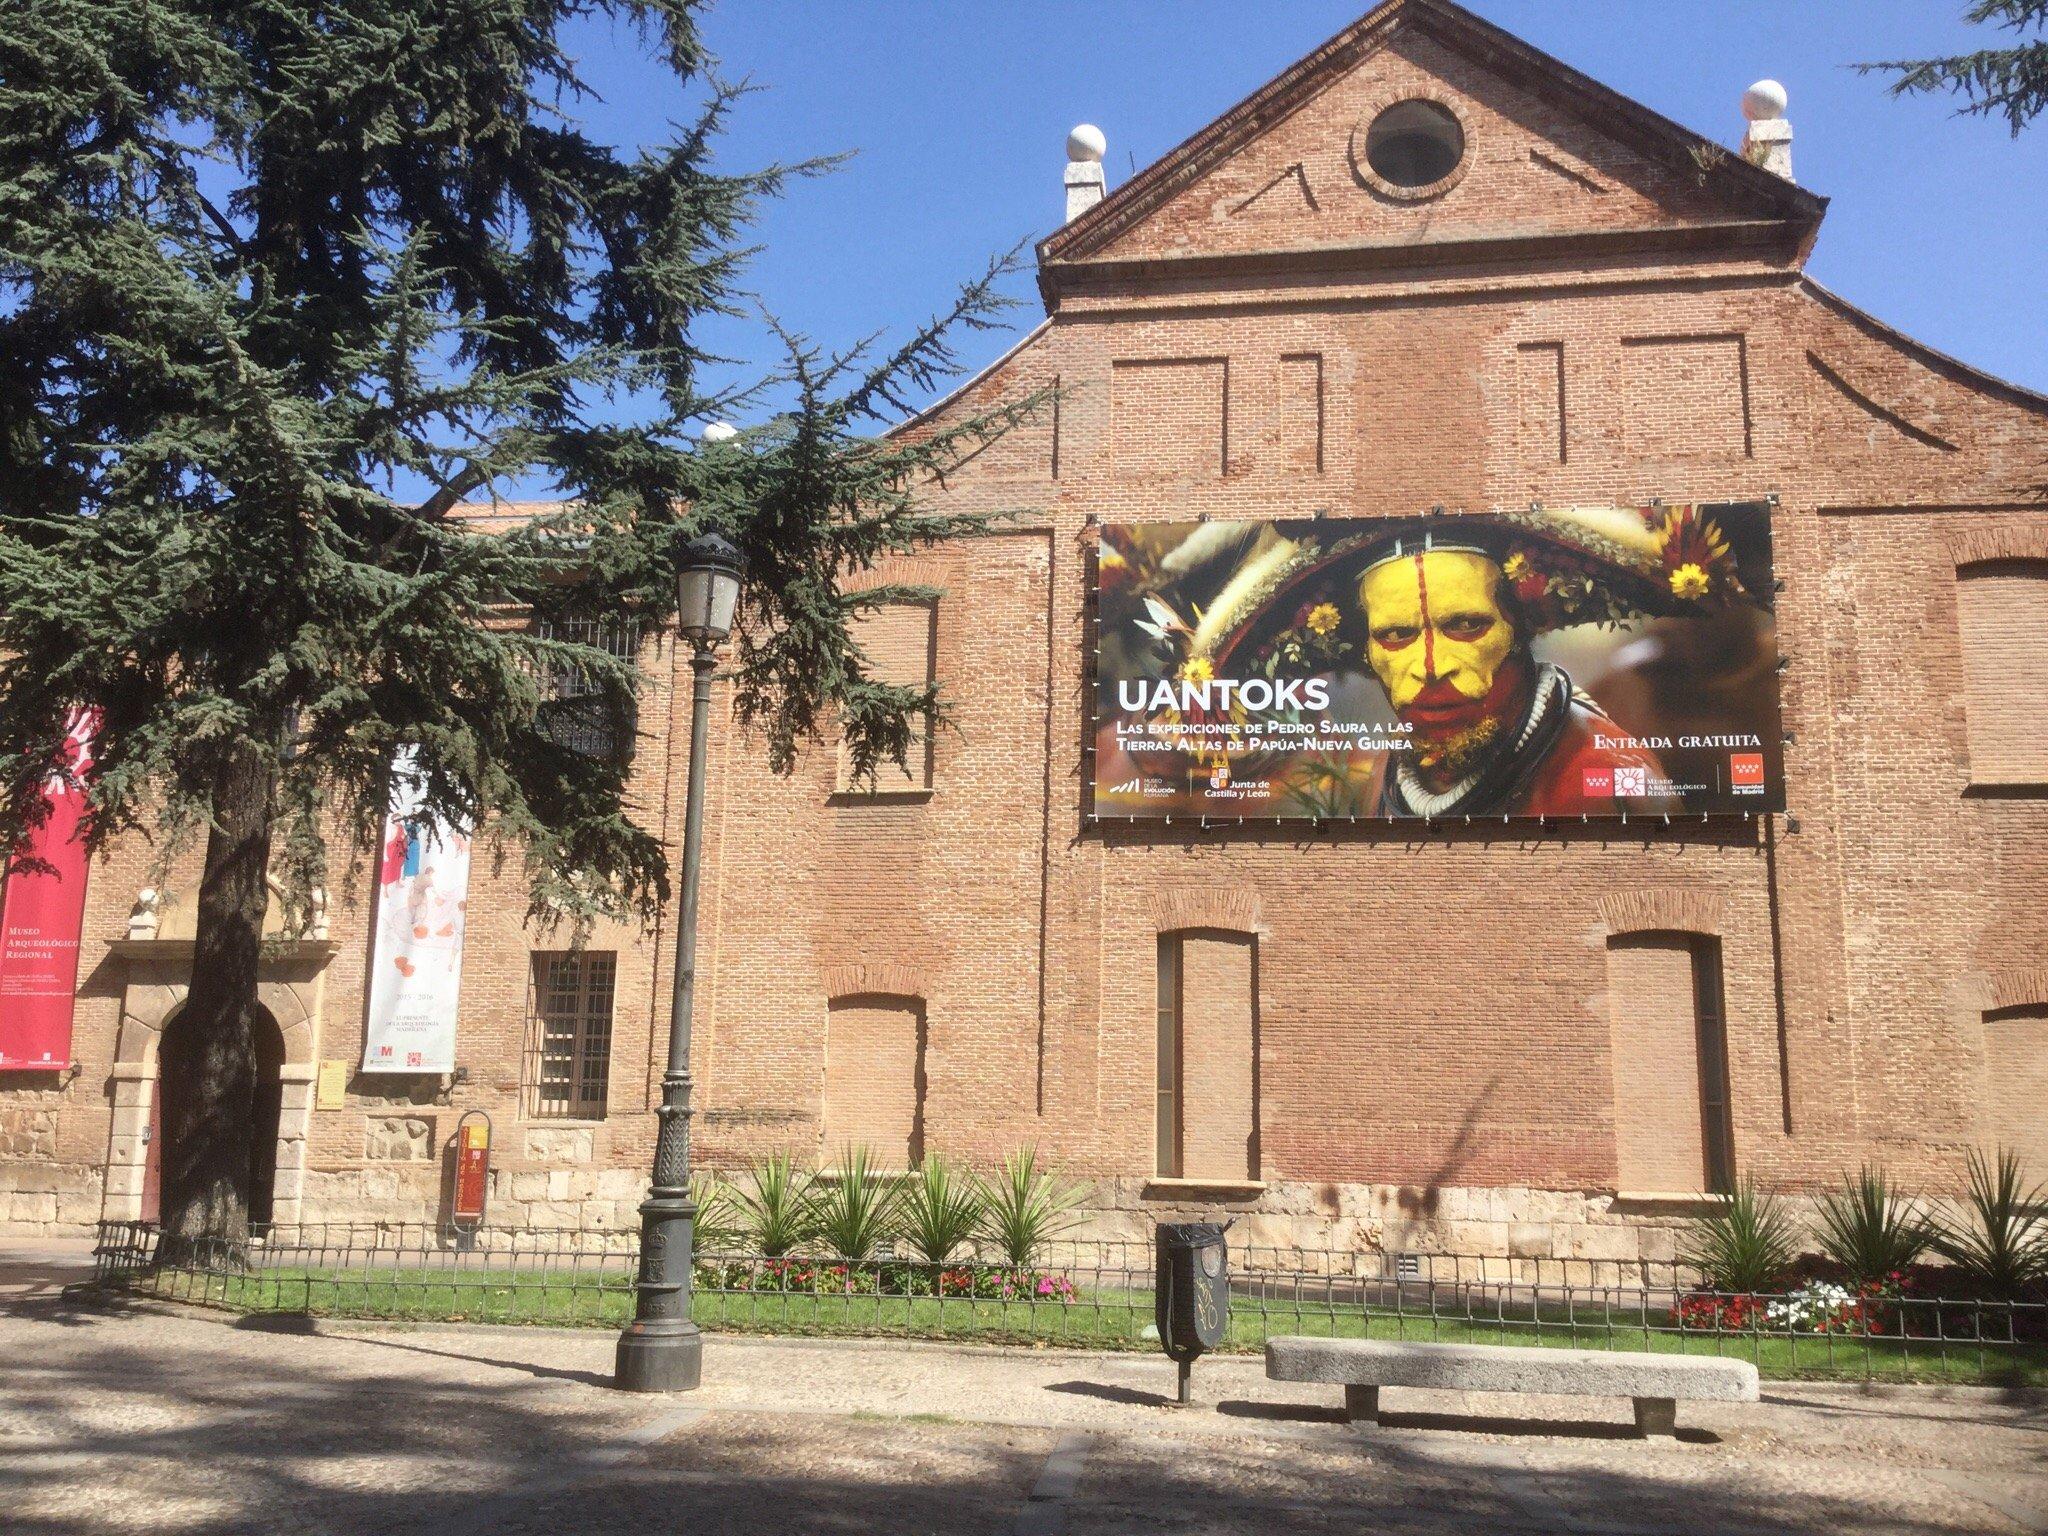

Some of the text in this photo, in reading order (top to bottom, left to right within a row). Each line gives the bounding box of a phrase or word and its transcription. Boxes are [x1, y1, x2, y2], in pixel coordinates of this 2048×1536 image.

[1119, 679, 1330, 711] UANTOKS
[1116, 720, 1413, 734] LAS EXPEDICIONES DE PEDRO SAURA A LAS
[1116, 737, 1413, 751] TIERRAS ALTAS DE PAPÚA-NUEVA GUINEA
[1594, 734, 1761, 749] ENTRADA GRATUITA
[1229, 780, 1270, 789] Junta de
[1204, 789, 1270, 799] Castilla y León
[9, 927, 40, 936] MUSEO
[6, 951, 54, 959] REGIONAL
